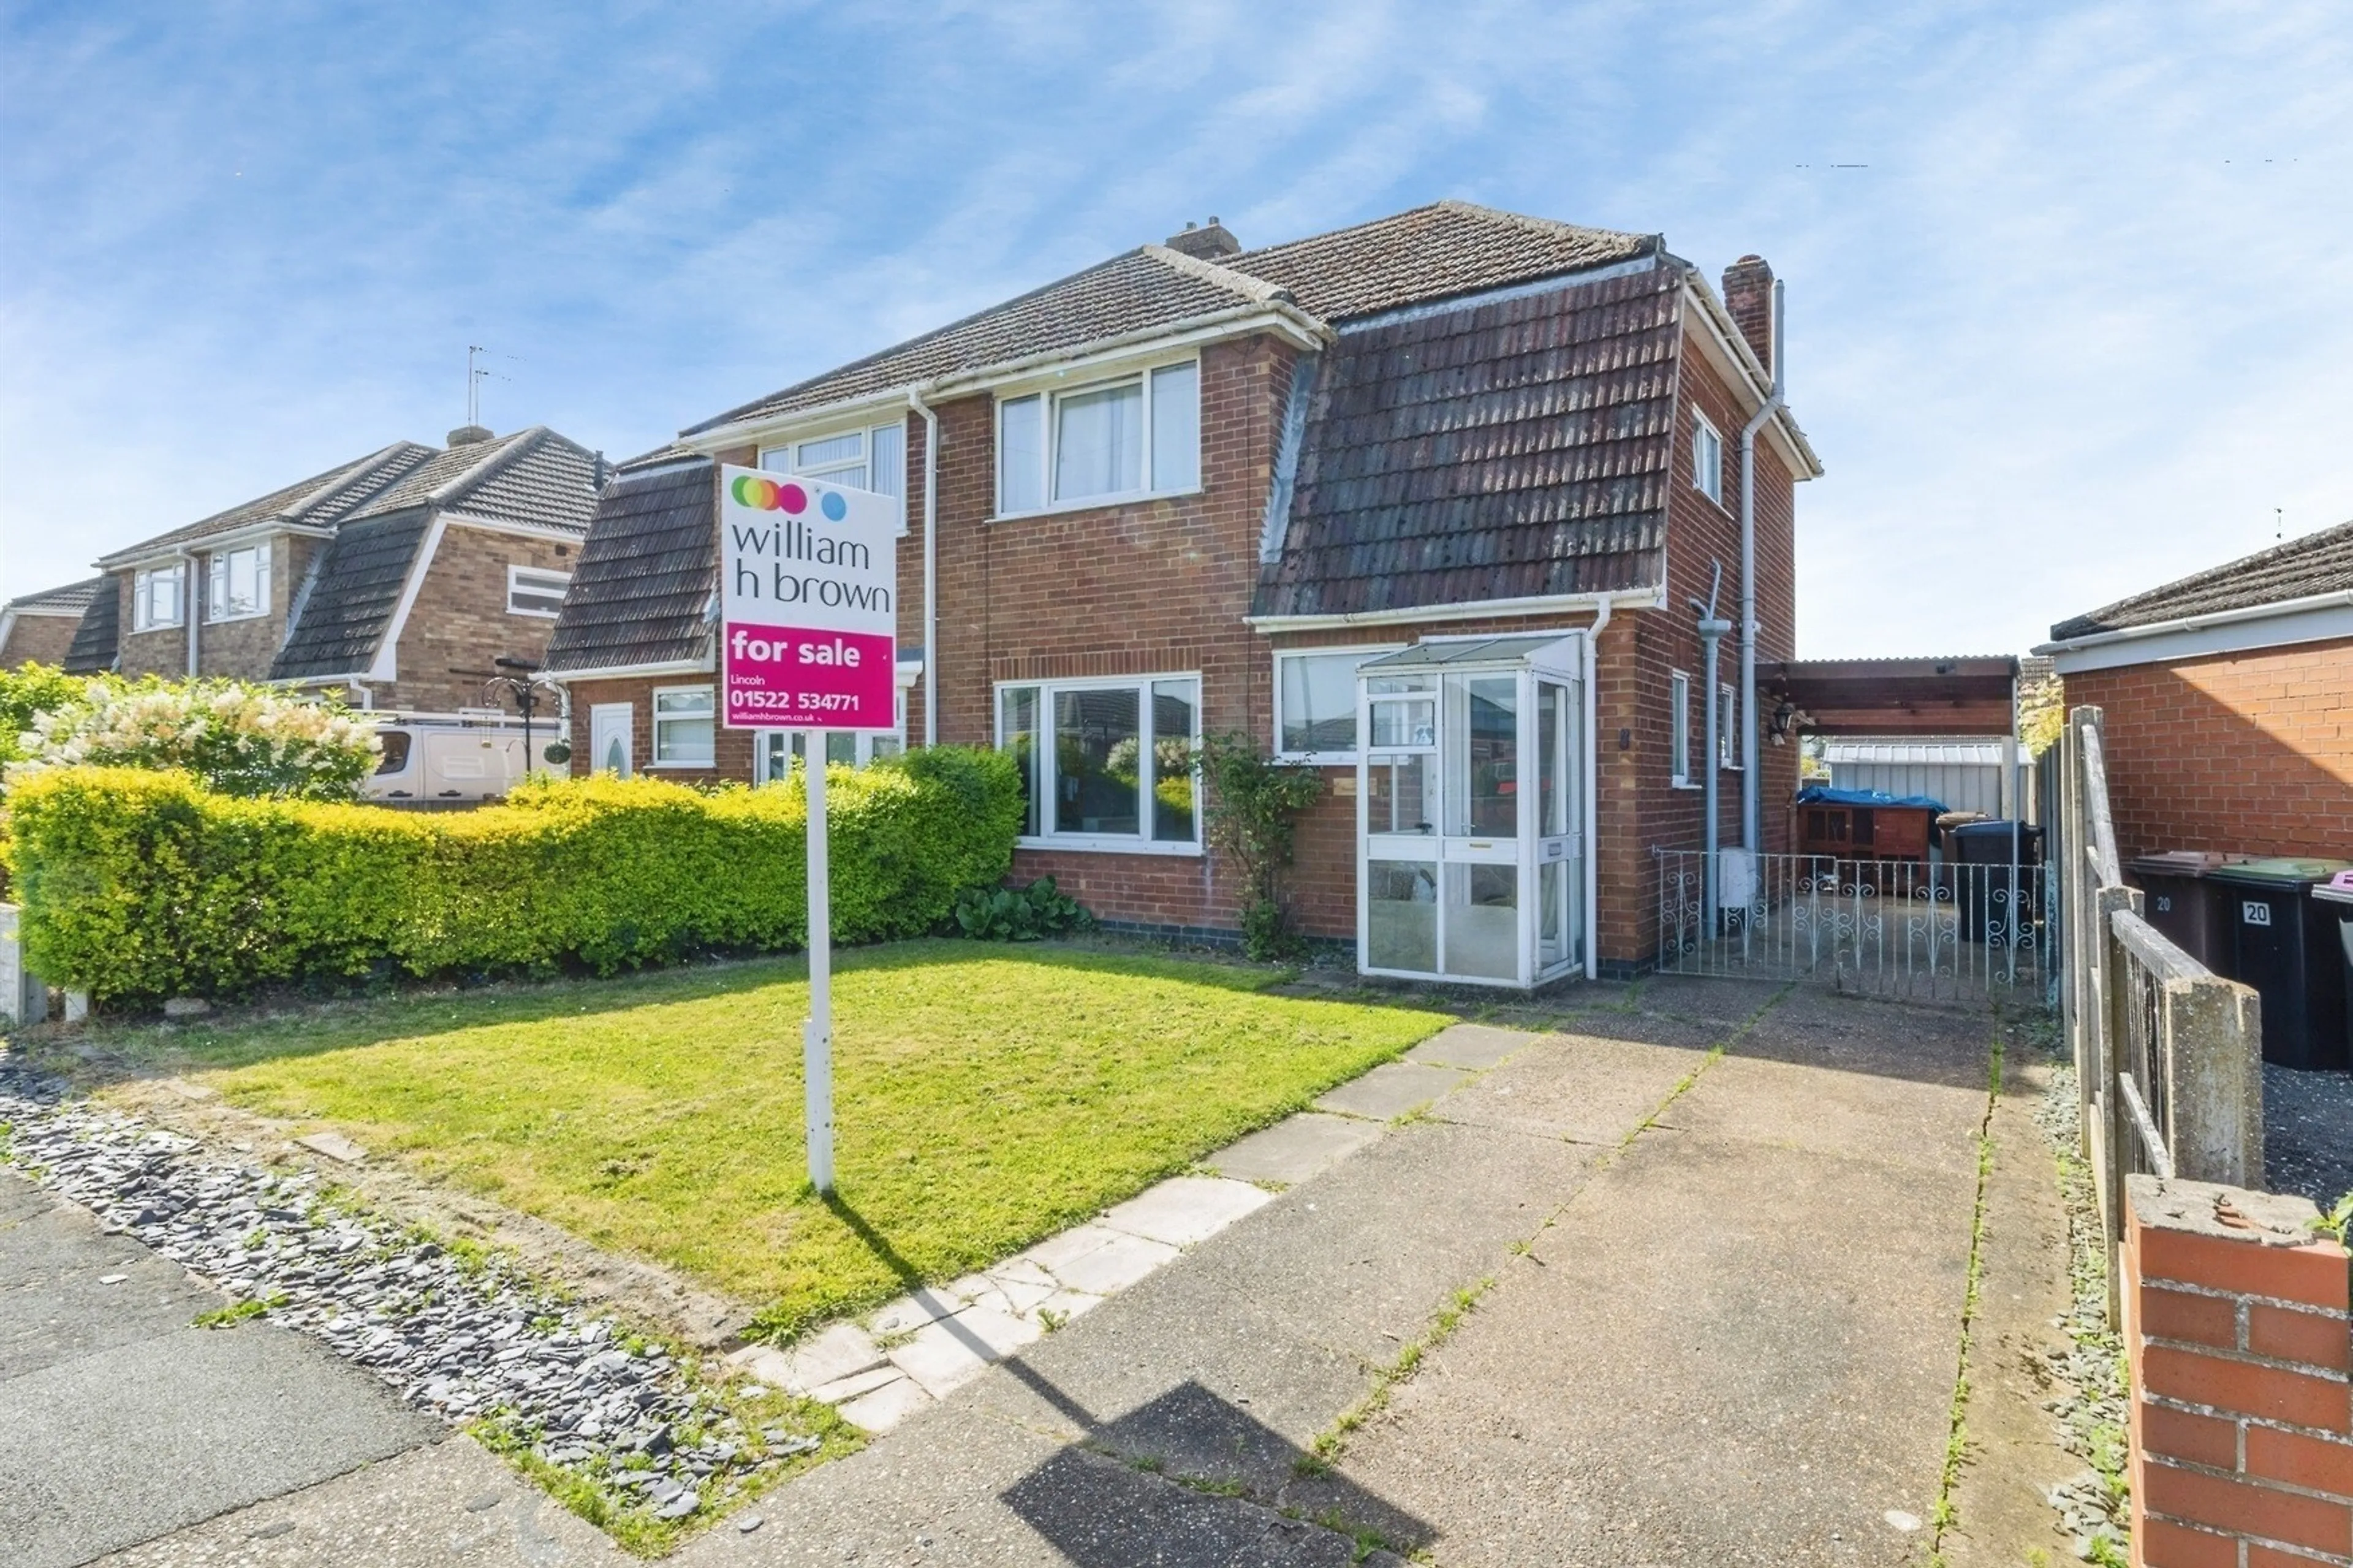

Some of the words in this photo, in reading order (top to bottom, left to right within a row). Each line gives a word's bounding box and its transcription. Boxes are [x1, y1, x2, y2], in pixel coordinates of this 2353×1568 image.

[732, 520, 869, 569] william
[737, 558, 759, 597] h
[775, 562, 889, 613] brown
[731, 631, 787, 662] for
[798, 638, 860, 667] sale
[730, 674, 765, 685] Lincoln
[731, 690, 790, 708] 01522
[798, 692, 859, 711] 534771
[732, 711, 814, 722] williamhbrown.co.uk
[2157, 896, 2170, 912] 20
[2247, 904, 2267, 922] 20
